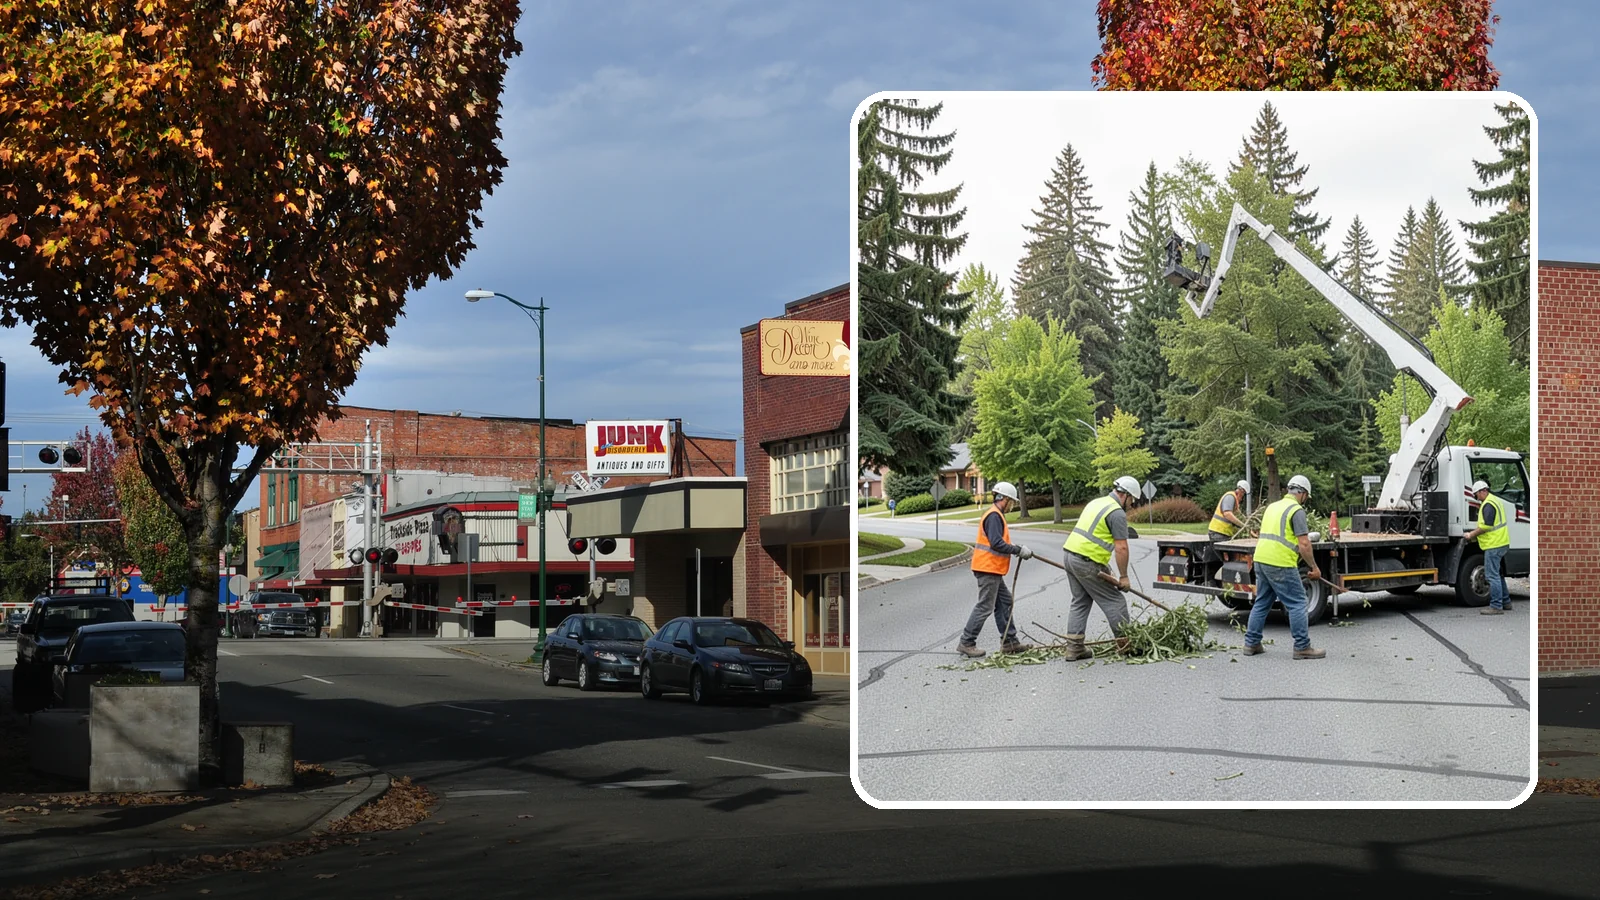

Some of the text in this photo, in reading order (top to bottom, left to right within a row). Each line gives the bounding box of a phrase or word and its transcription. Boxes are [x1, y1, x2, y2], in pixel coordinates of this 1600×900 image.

[765, 328, 831, 365] Decor
[595, 425, 665, 457] JUNK
[607, 446, 646, 454] DISORDERLY
[597, 460, 665, 470] ANTIQUES AND GIFTS
[573, 473, 588, 491] RAIL
[590, 476, 608, 492] SING
[390, 519, 429, 540] Trackside Pizza
